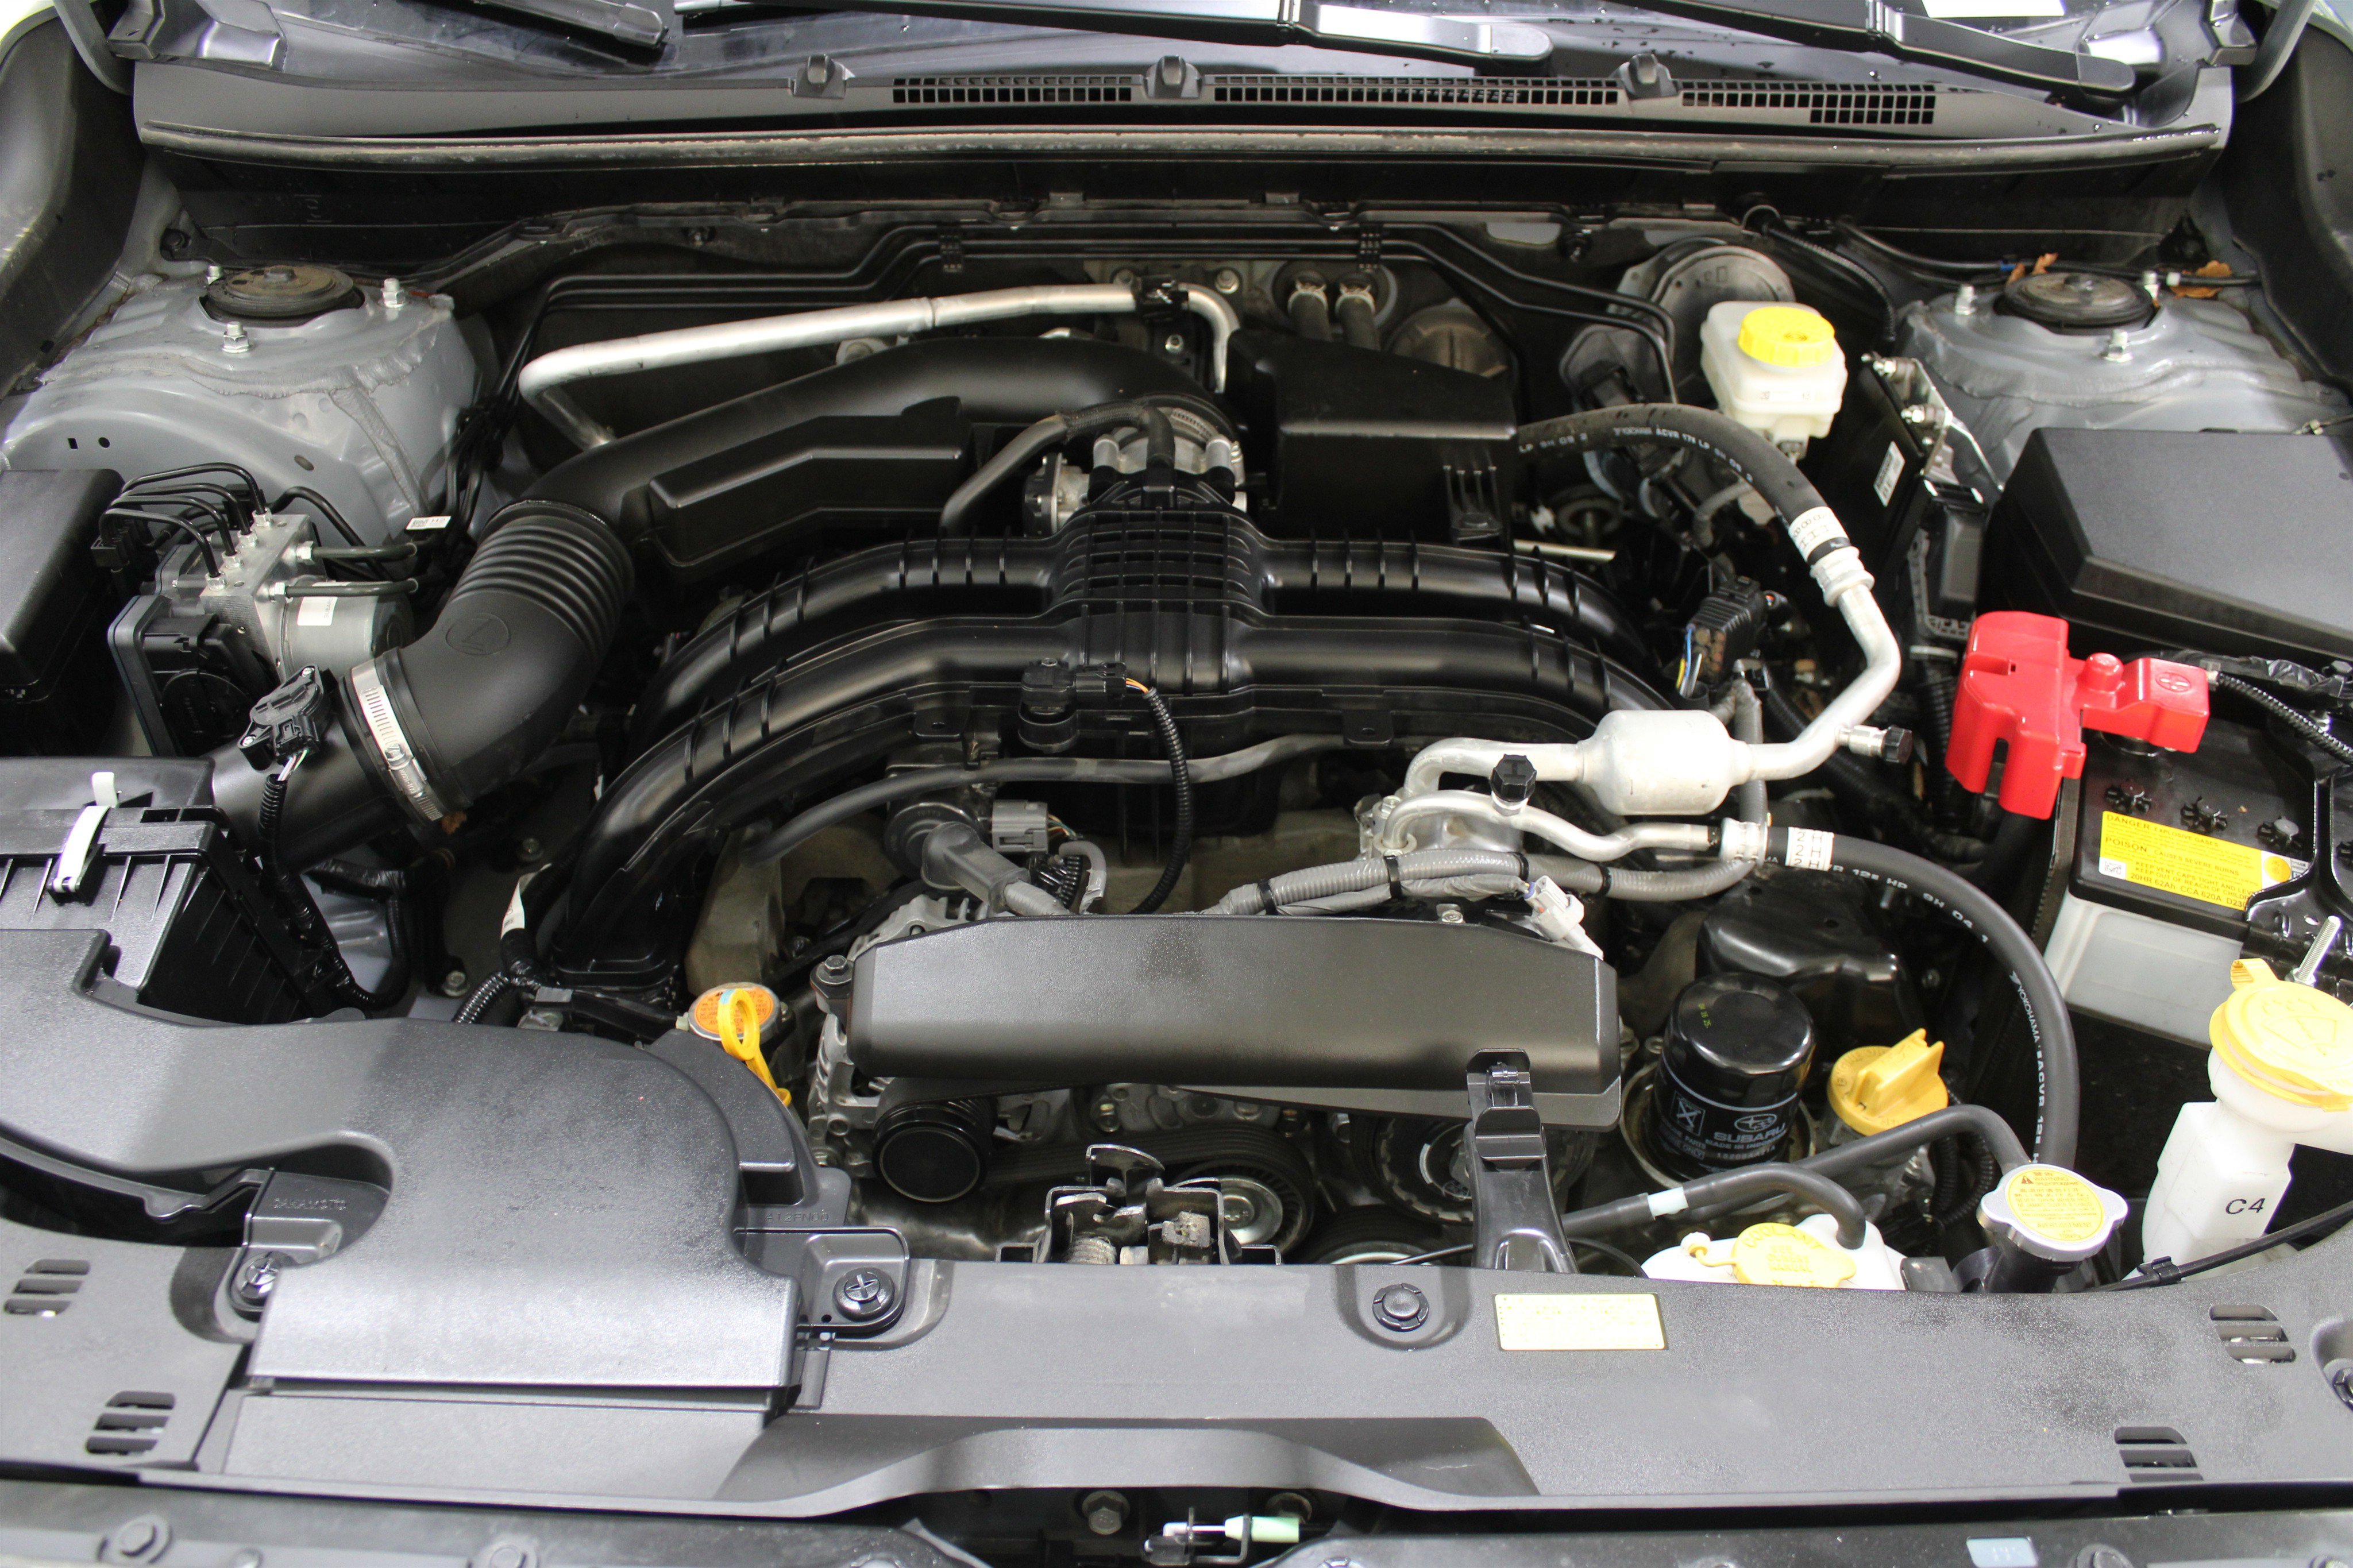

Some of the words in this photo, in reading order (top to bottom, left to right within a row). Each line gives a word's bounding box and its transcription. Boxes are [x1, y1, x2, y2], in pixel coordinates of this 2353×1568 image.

[2107, 814, 2150, 829] DANGER
[2155, 827, 2191, 840] EXPLOSIVE
[2194, 837, 2219, 847] GASES
[1795, 844, 1803, 856] 2
[1810, 845, 1822, 858] H
[2105, 837, 2147, 852] POISON
[2155, 850, 2182, 860] CAUSES
[2185, 857, 2211, 868] SEVERE
[2215, 866, 2239, 876] BURNS
[2131, 873, 2152, 885] 20HR
[2155, 879, 2176, 890] 62Ah
[2181, 886, 2200, 896] CCA
[2201, 891, 2221, 902] 620A
[2136, 867, 2154, 875] KEEP
[2185, 879, 2209, 889] REACH
[2157, 866, 2174, 874] VENT
[2177, 871, 2196, 880] CAPS
[2198, 876, 2219, 886] TIGHT
[2221, 882, 2236, 891] AND
[2018, 985, 2040, 1043] YOKOHAMA
[1684, 1135, 1706, 1150] PARTS
[1714, 1122, 1785, 1143] SUBARU
[1705, 1139, 1731, 1149] MADE
[2225, 1198, 2265, 1214] C4
[765, 1212, 829, 1222] A12FN00
[1743, 1225, 1826, 1249] COOLANT
[1767, 1262, 1813, 1273] MANUAL
